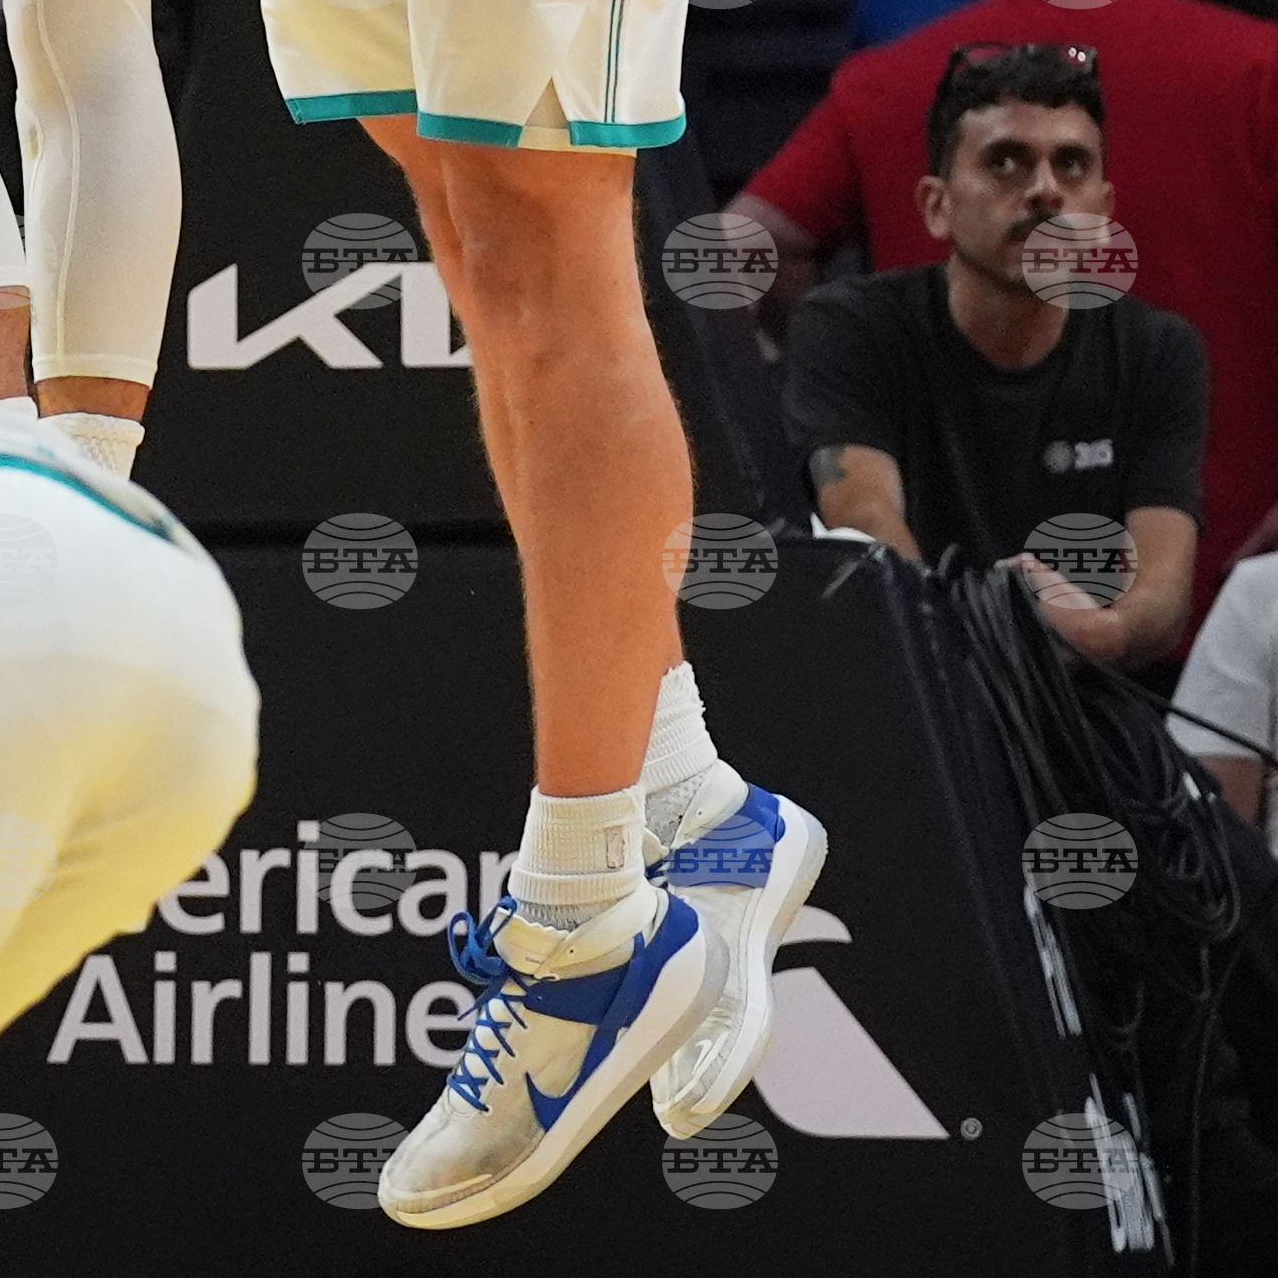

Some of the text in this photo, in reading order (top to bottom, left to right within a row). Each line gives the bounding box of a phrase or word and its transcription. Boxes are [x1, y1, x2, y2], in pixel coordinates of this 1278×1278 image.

[187, 262, 474, 369] KI
[122, 820, 515, 936] erica
[45, 950, 479, 1068] Airline
